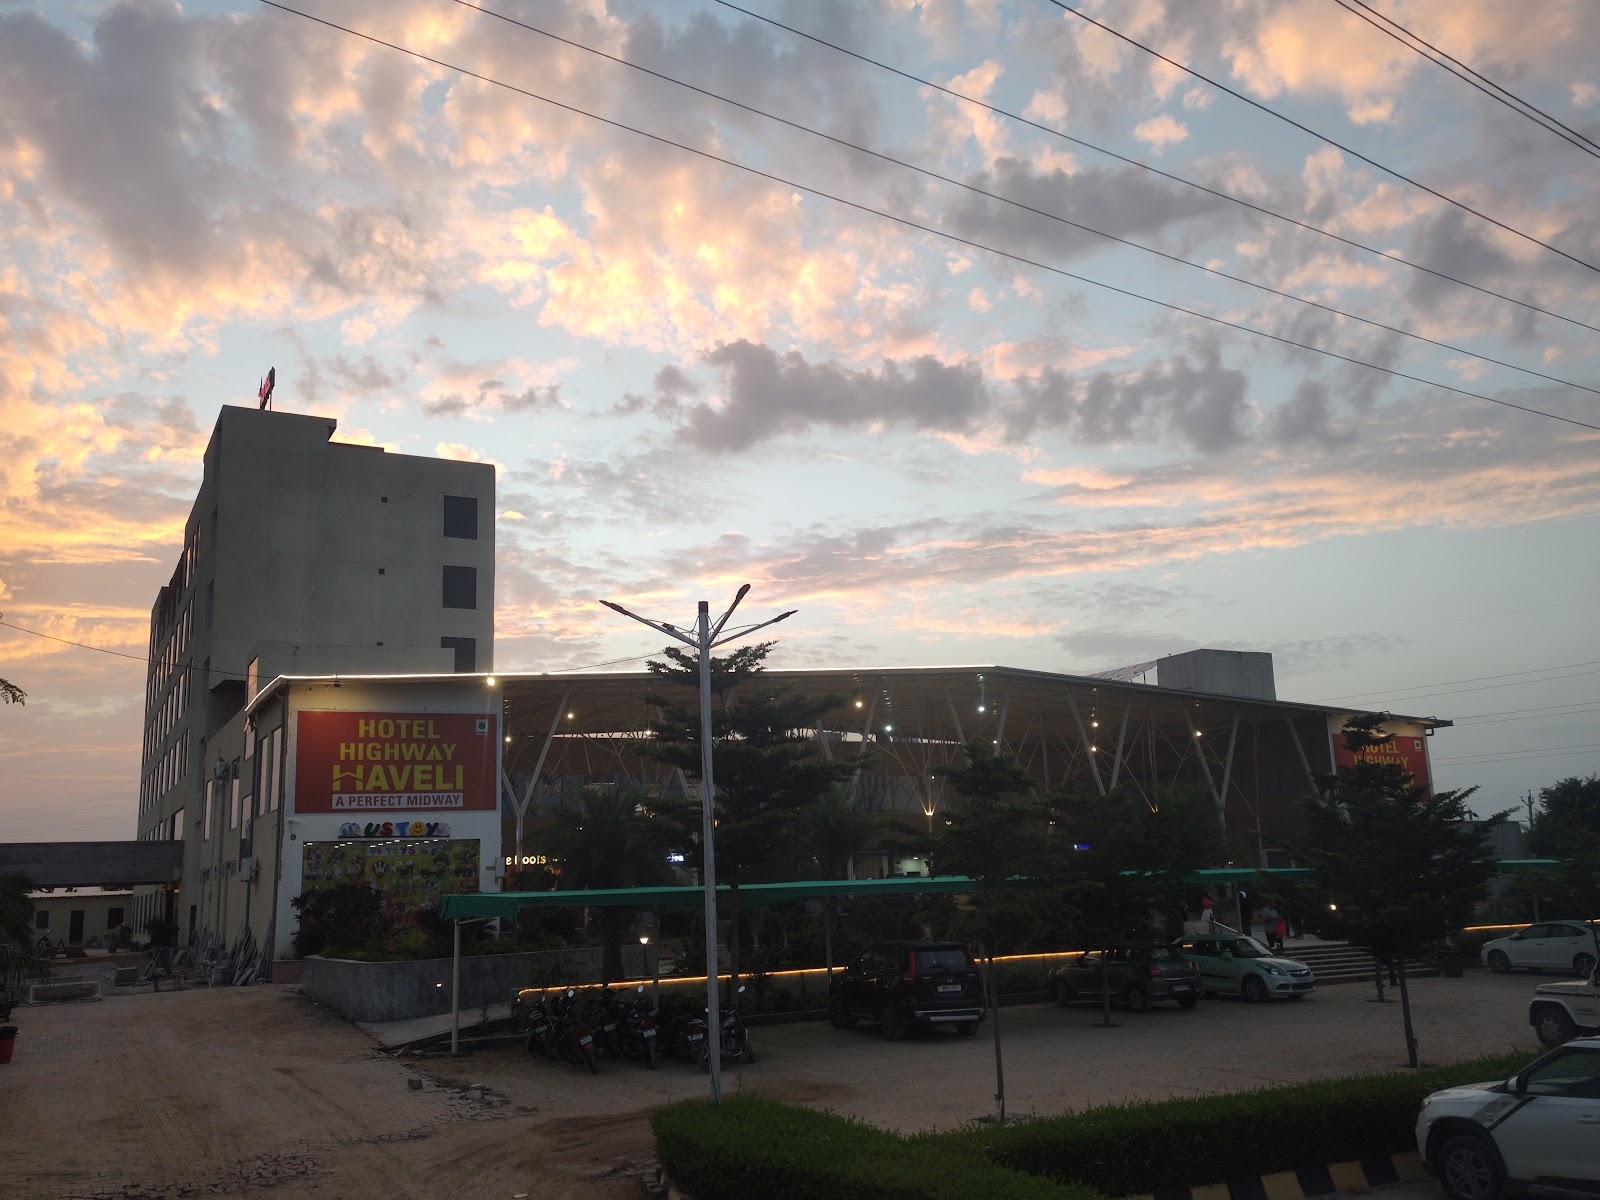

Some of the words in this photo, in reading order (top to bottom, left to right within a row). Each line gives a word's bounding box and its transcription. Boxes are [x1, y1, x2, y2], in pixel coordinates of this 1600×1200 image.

[358, 718, 441, 739] HOTEL
[339, 742, 457, 761] HIGHWAY
[332, 764, 464, 792] HAVELI
[335, 796, 345, 807] A
[348, 795, 403, 807] PERFECT
[406, 794, 460, 806] MIDWAY
